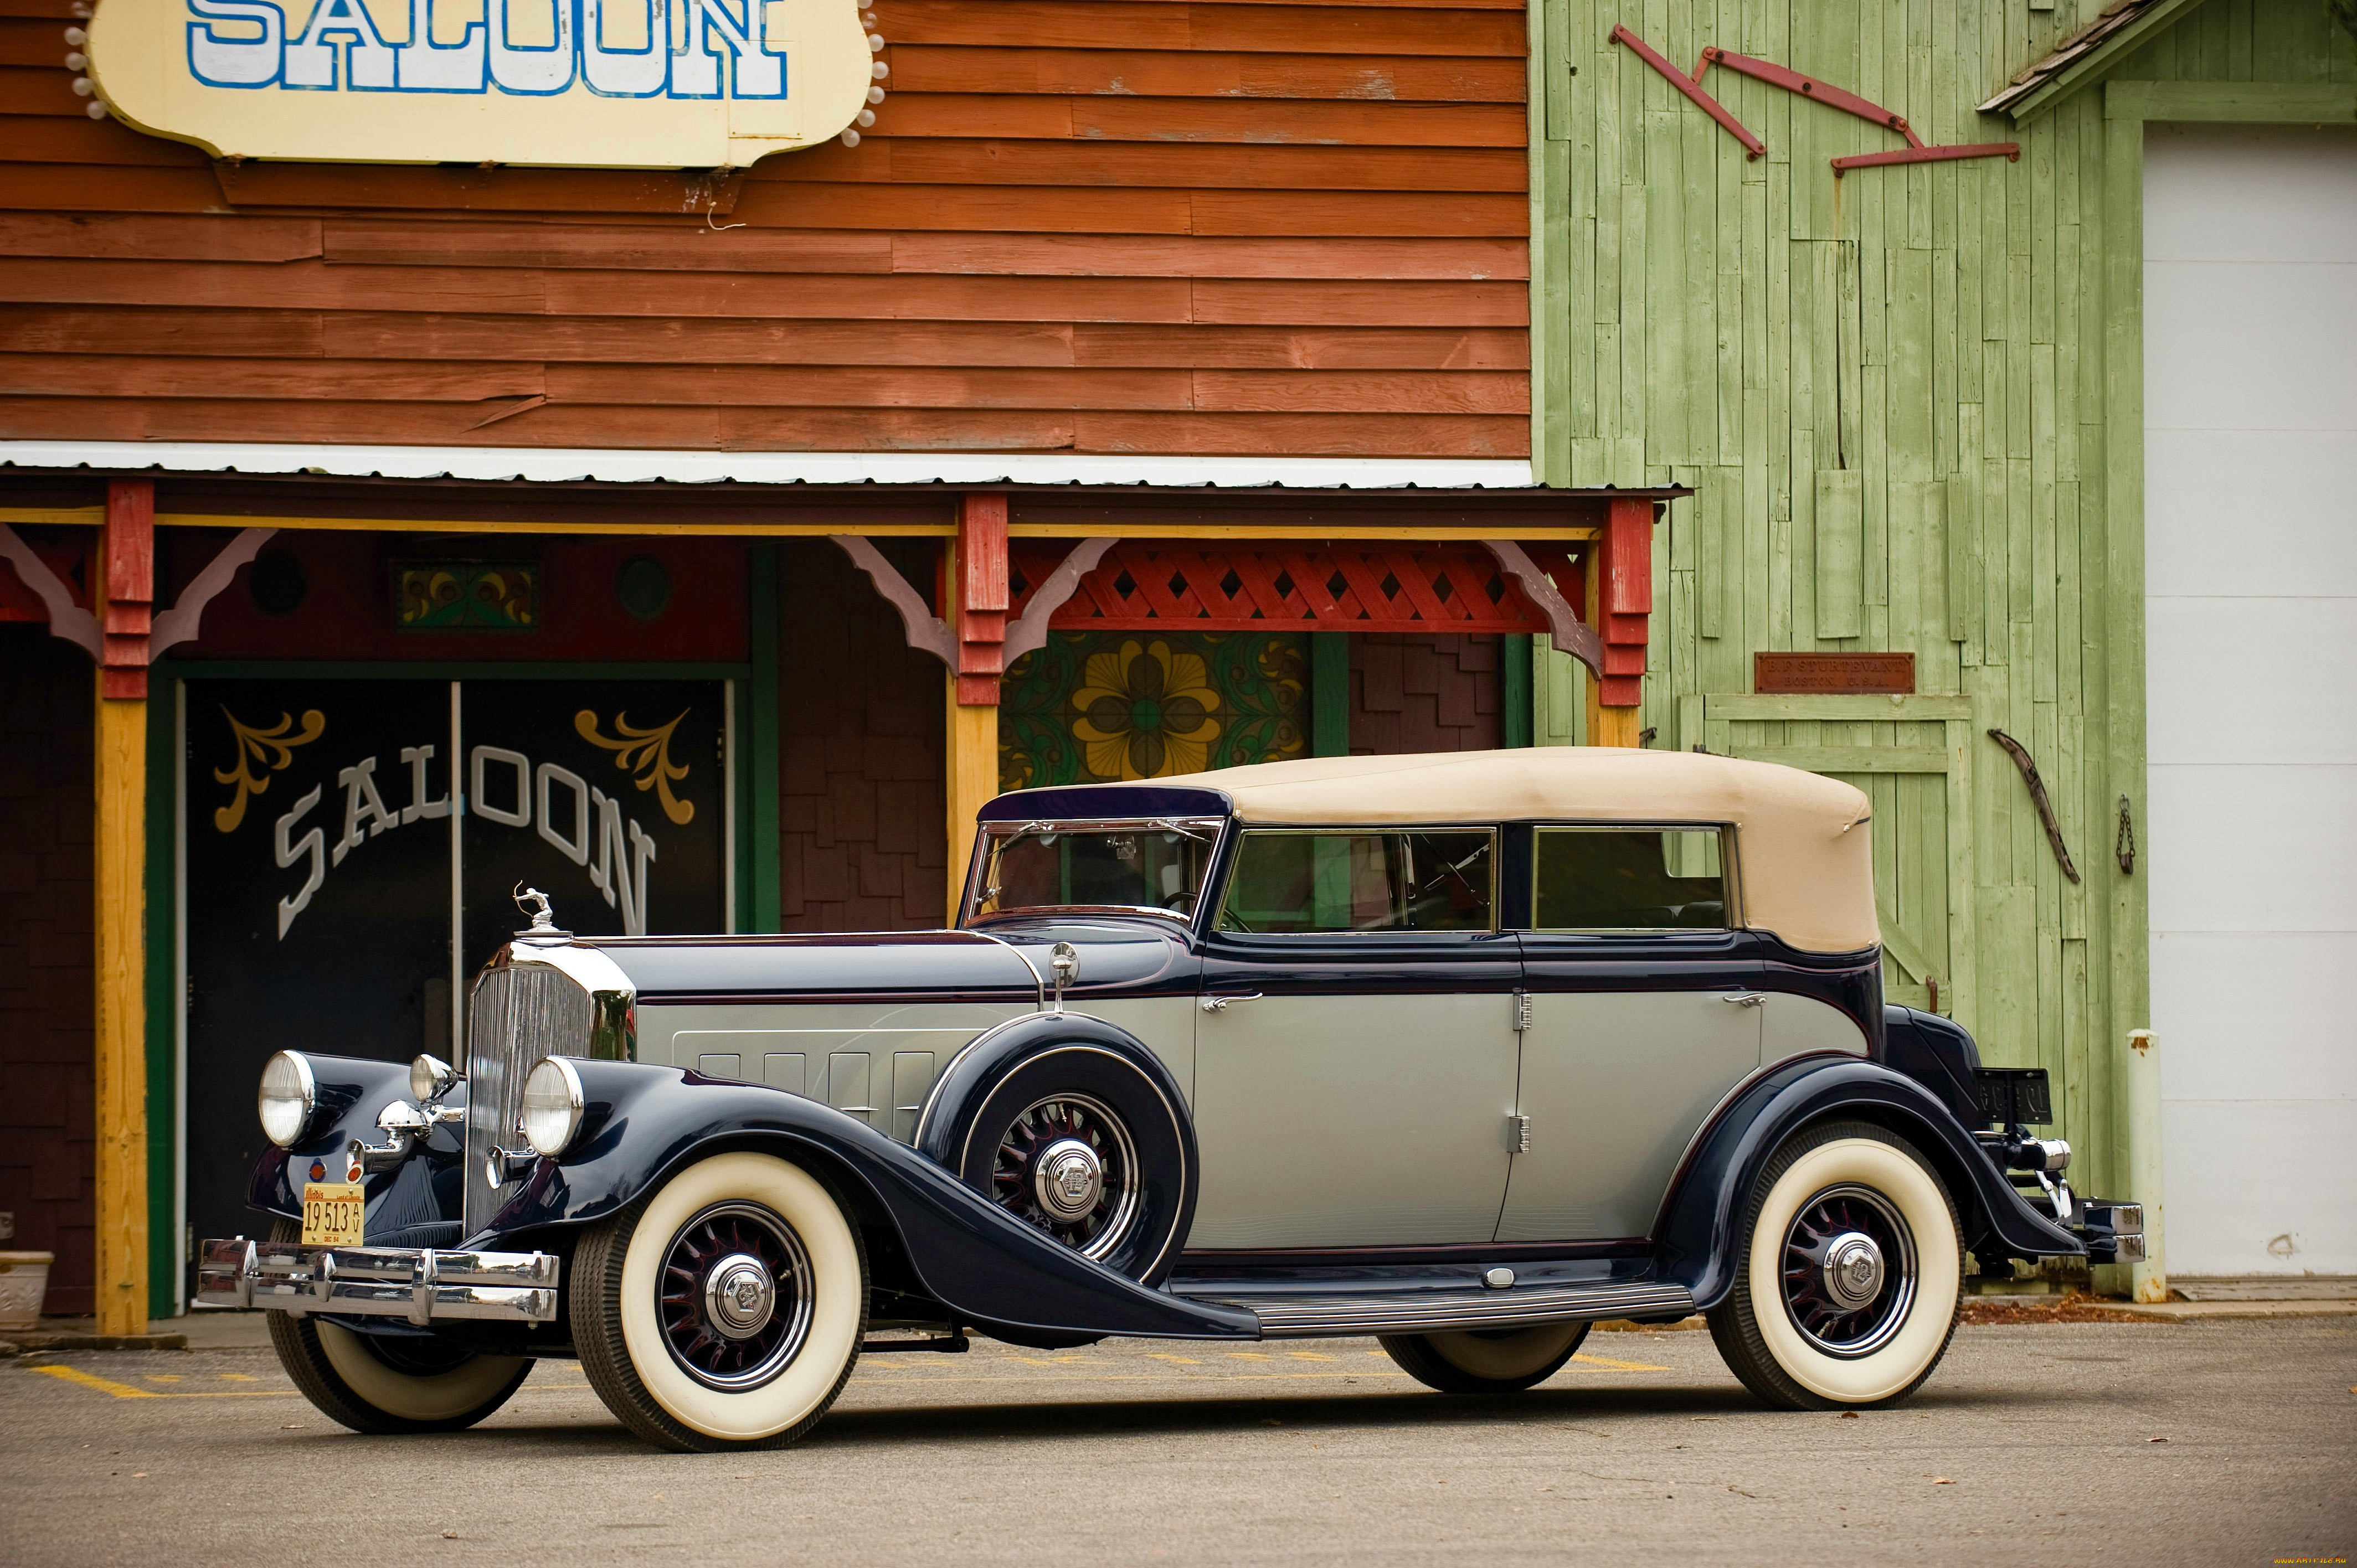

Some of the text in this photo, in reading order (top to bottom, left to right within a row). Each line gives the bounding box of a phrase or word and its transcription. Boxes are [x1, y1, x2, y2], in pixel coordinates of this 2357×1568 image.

[275, 744, 656, 941] SALOON
[305, 1188, 323, 1199] Illinois
[305, 1202, 321, 1231] 19
[325, 1202, 348, 1232] 513
